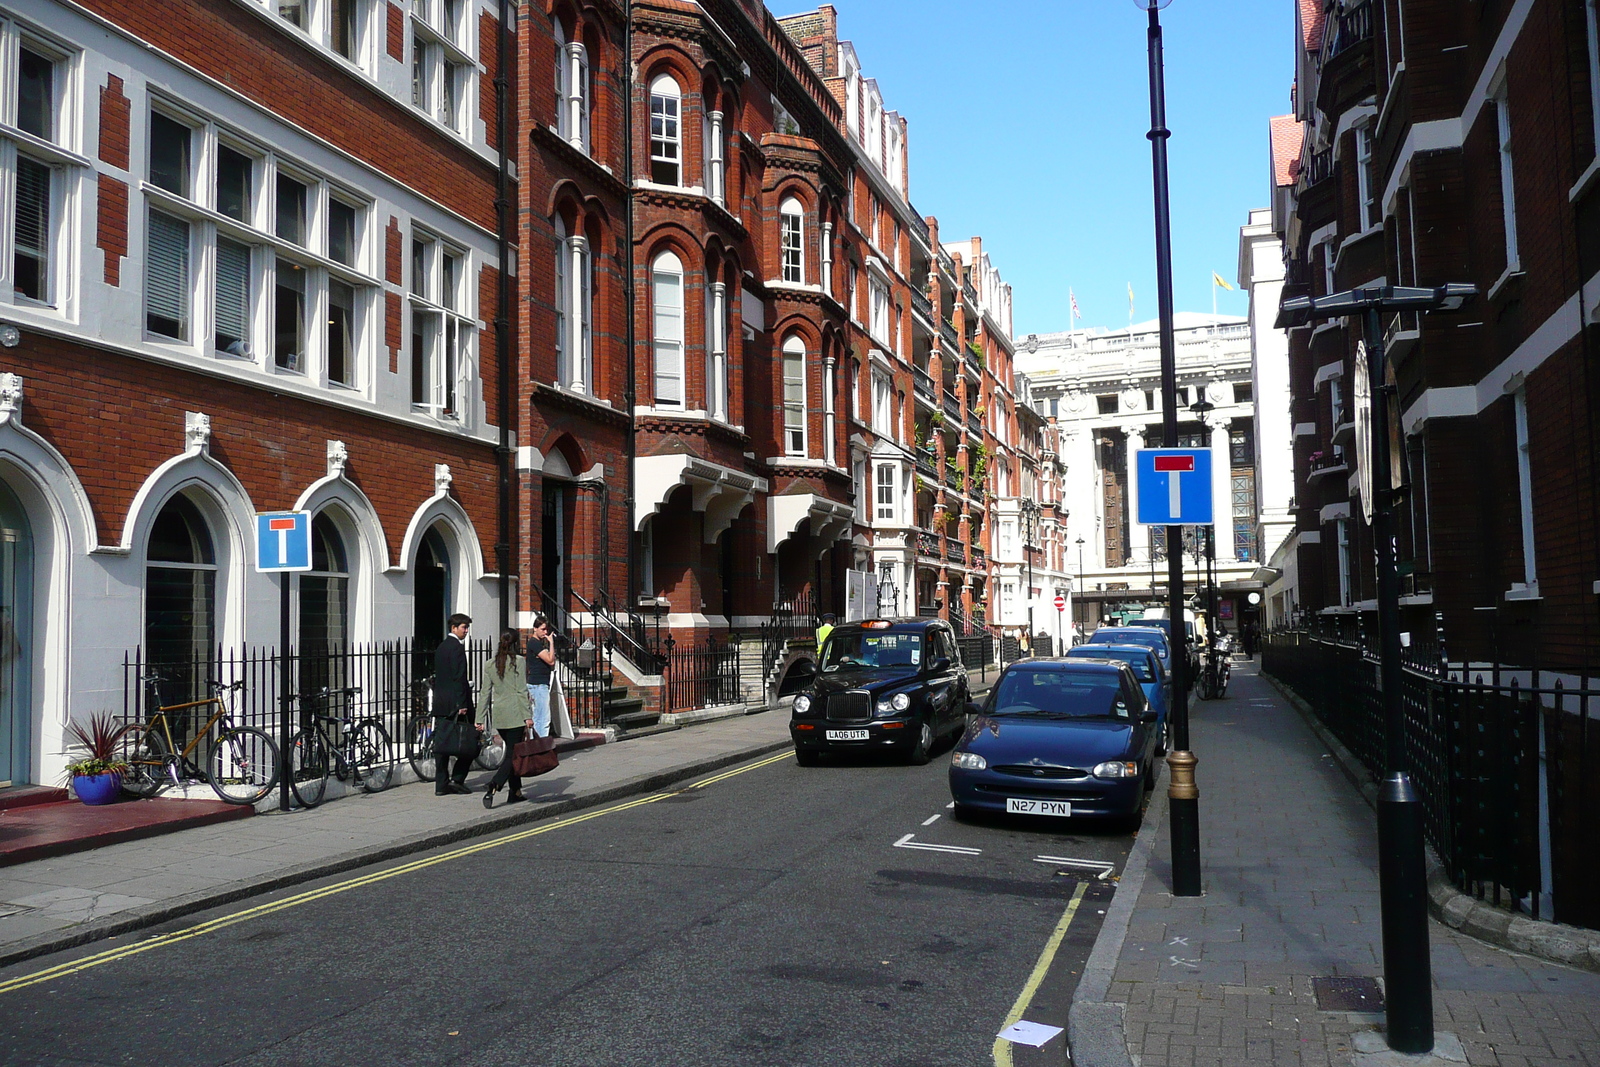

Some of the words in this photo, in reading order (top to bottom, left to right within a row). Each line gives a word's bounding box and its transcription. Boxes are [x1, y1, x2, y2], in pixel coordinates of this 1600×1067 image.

[850, 730, 866, 738] UTR
[1012, 800, 1036, 811] N27
[1041, 802, 1066, 814] PYN
